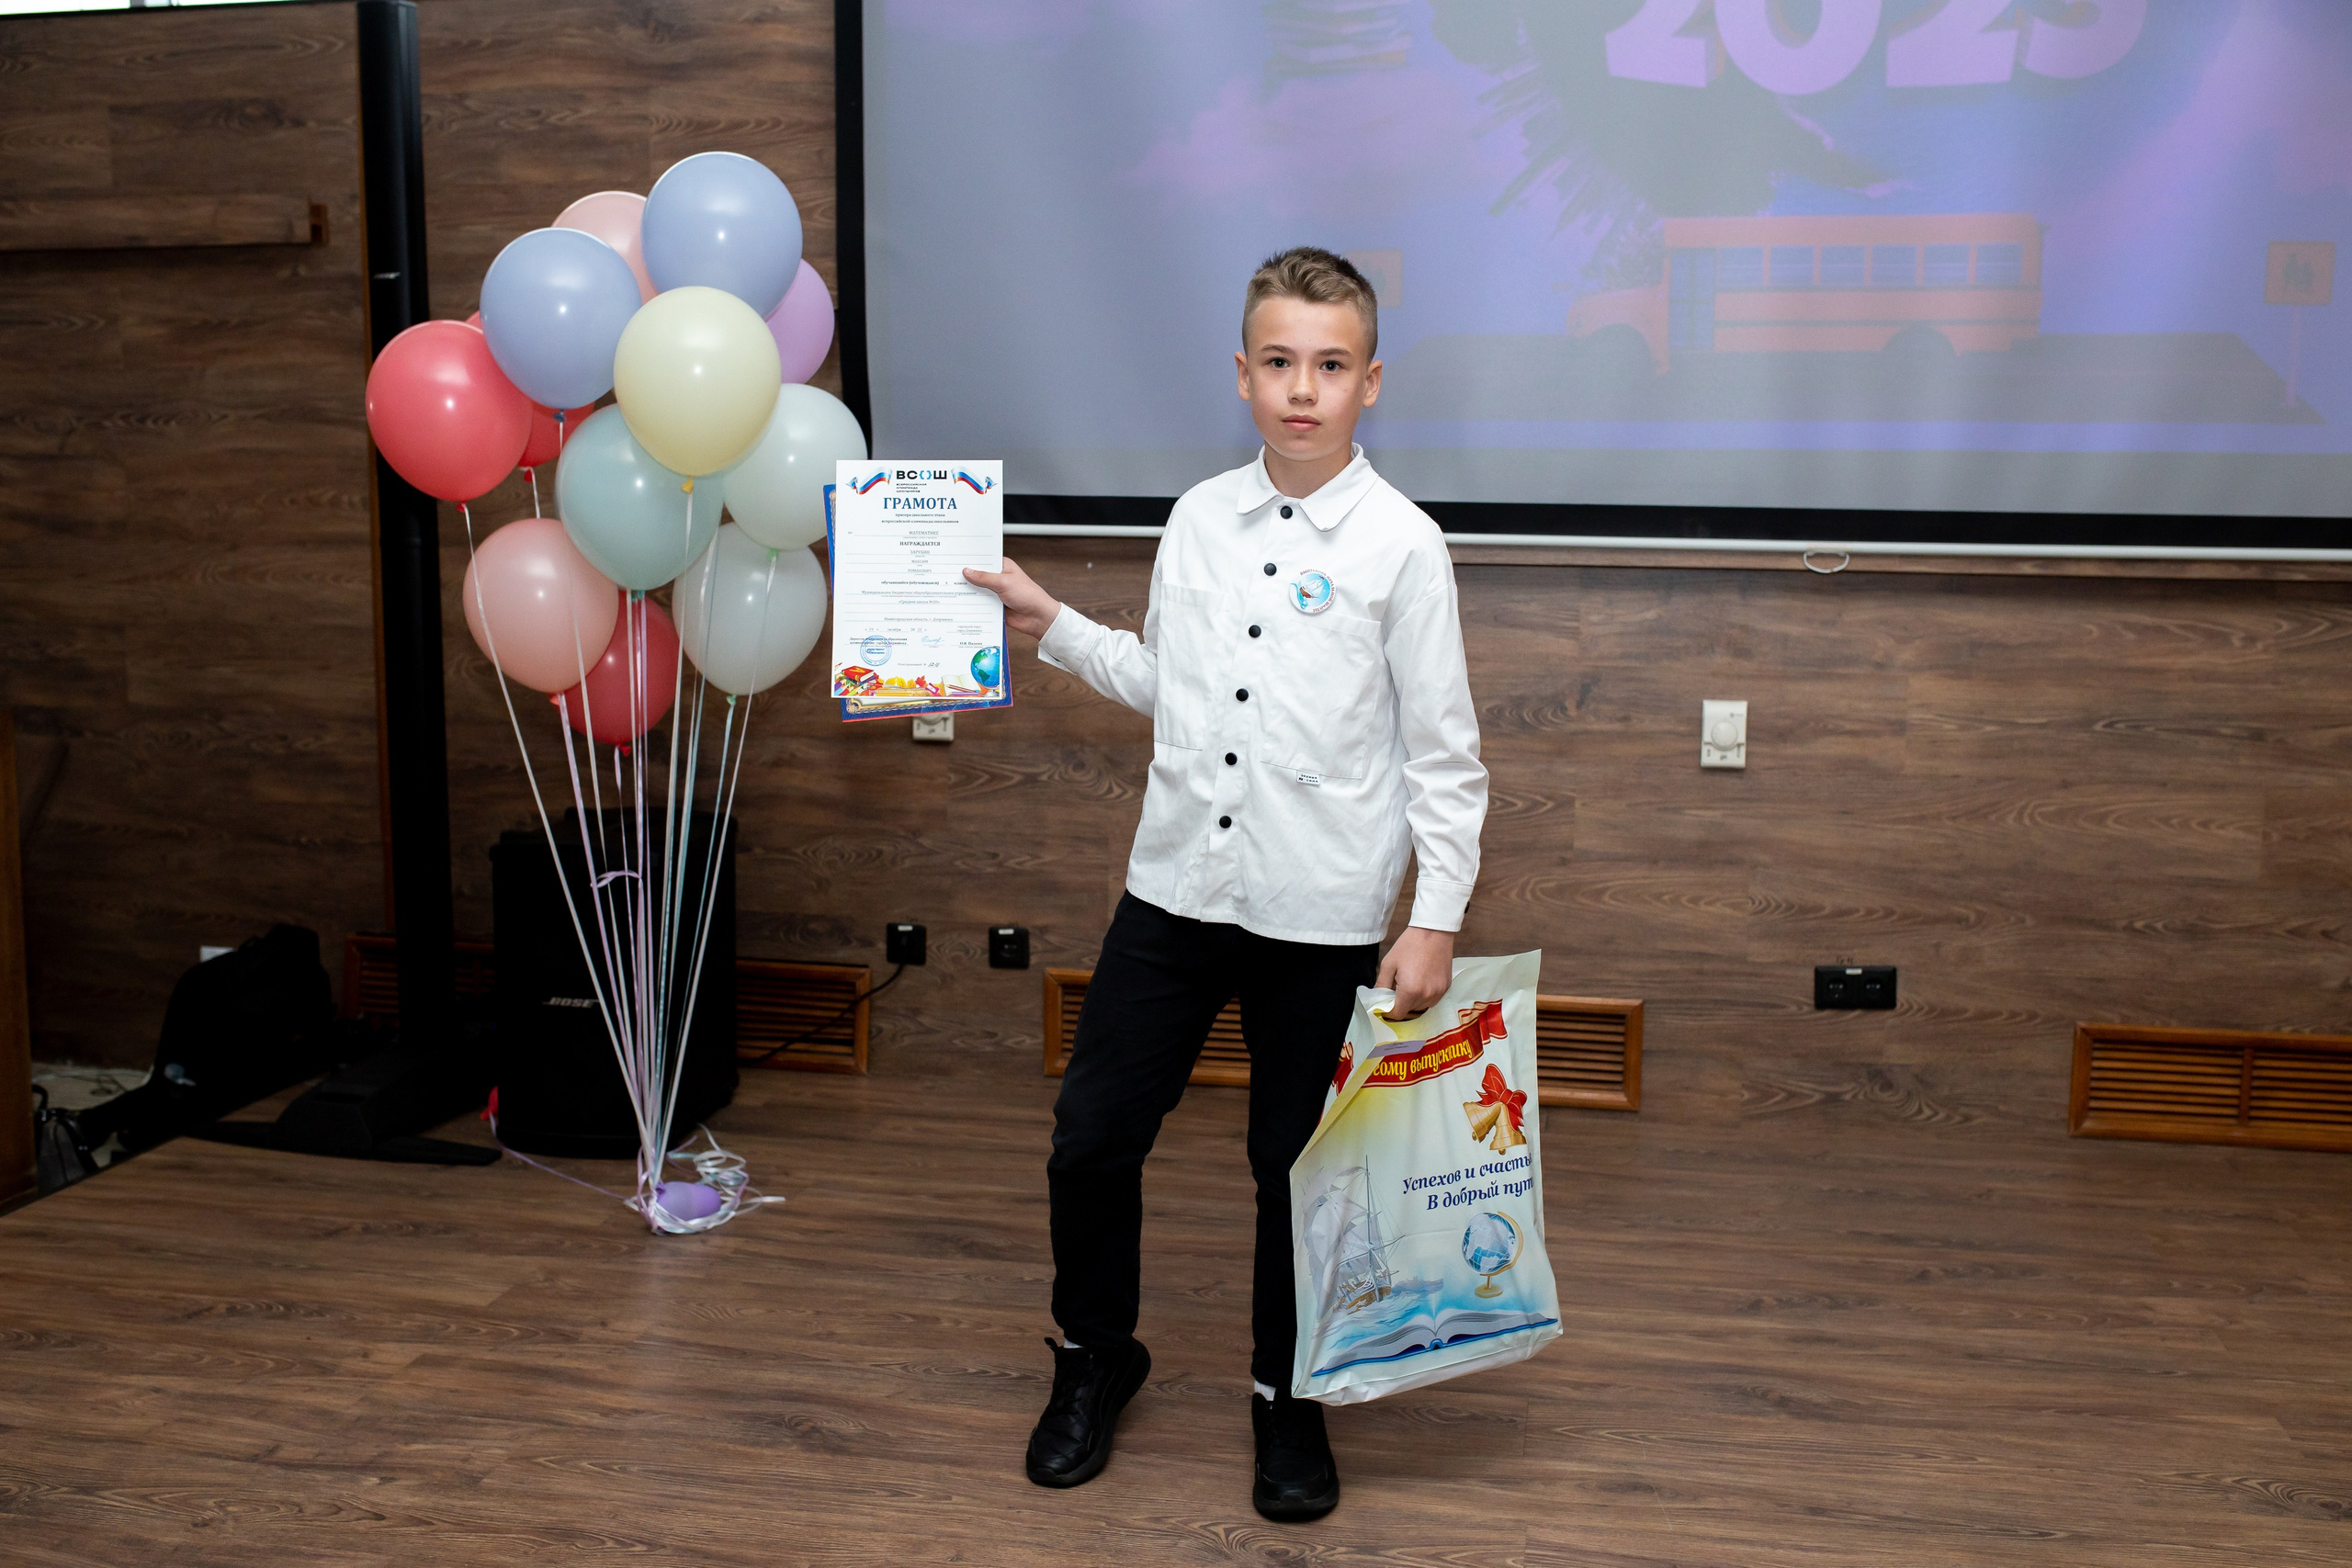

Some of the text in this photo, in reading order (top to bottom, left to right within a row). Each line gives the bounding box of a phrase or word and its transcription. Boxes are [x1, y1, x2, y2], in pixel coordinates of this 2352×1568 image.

[883, 497, 957, 510] ГРАМОТА
[550, 997, 594, 1009] BOSE
[1402, 1152, 1533, 1194] Успехов и счасть
[1426, 1176, 1534, 1211] В добрый пут
